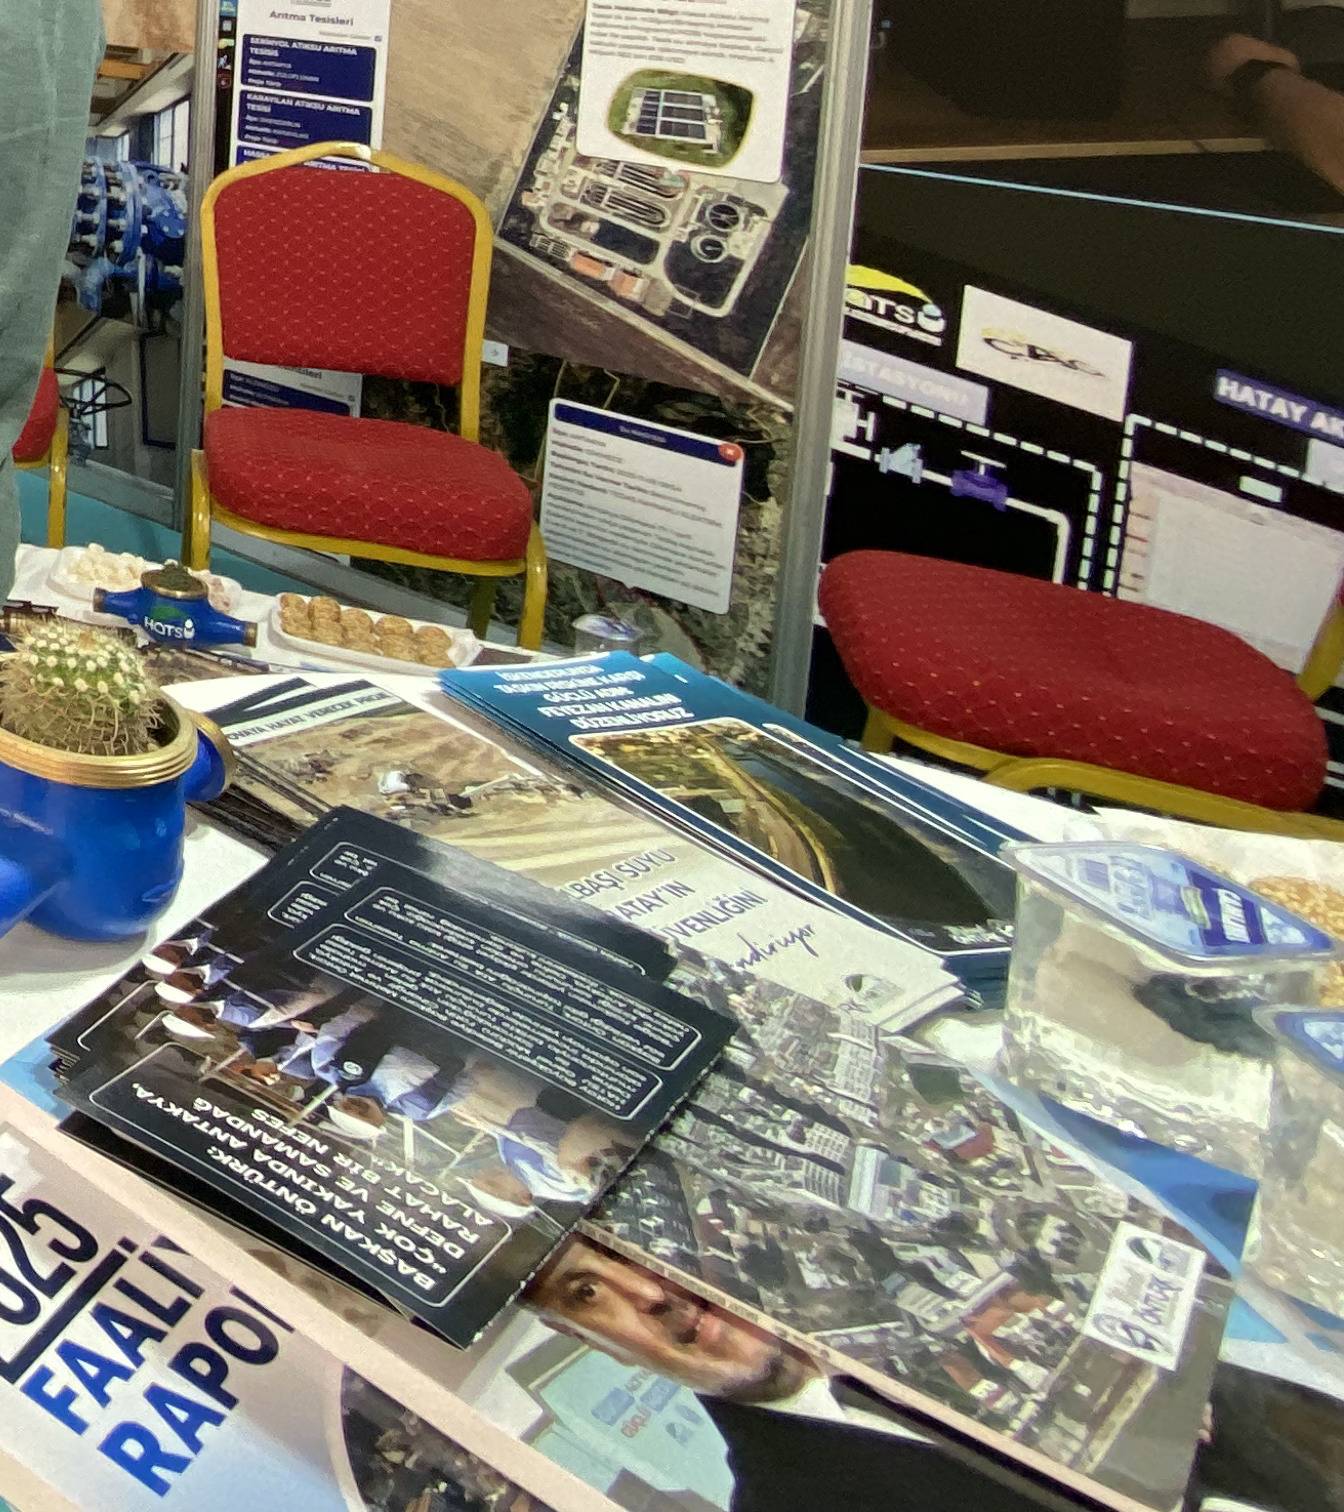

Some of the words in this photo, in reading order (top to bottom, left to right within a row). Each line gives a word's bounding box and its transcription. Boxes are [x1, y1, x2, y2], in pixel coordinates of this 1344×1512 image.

[269, 10, 307, 23] Arıtma
[309, 13, 354, 26] Tesisleri
[1218, 376, 1309, 423] HATAY
[618, 848, 675, 884] SUYU
[187, 1094, 334, 1181] SAMANDAĞ
[248, 1106, 330, 1155] NEFES
[200, 1144, 319, 1216] ÖNTÜRK:
[246, 1148, 373, 1224] YAKINDA
[328, 1152, 382, 1185] BİR
[333, 1176, 374, 1202] VE
[371, 1199, 468, 1259] DEFNE
[381, 1182, 482, 1243] RAHAT
[315, 1212, 441, 1290] BAŞKAN
